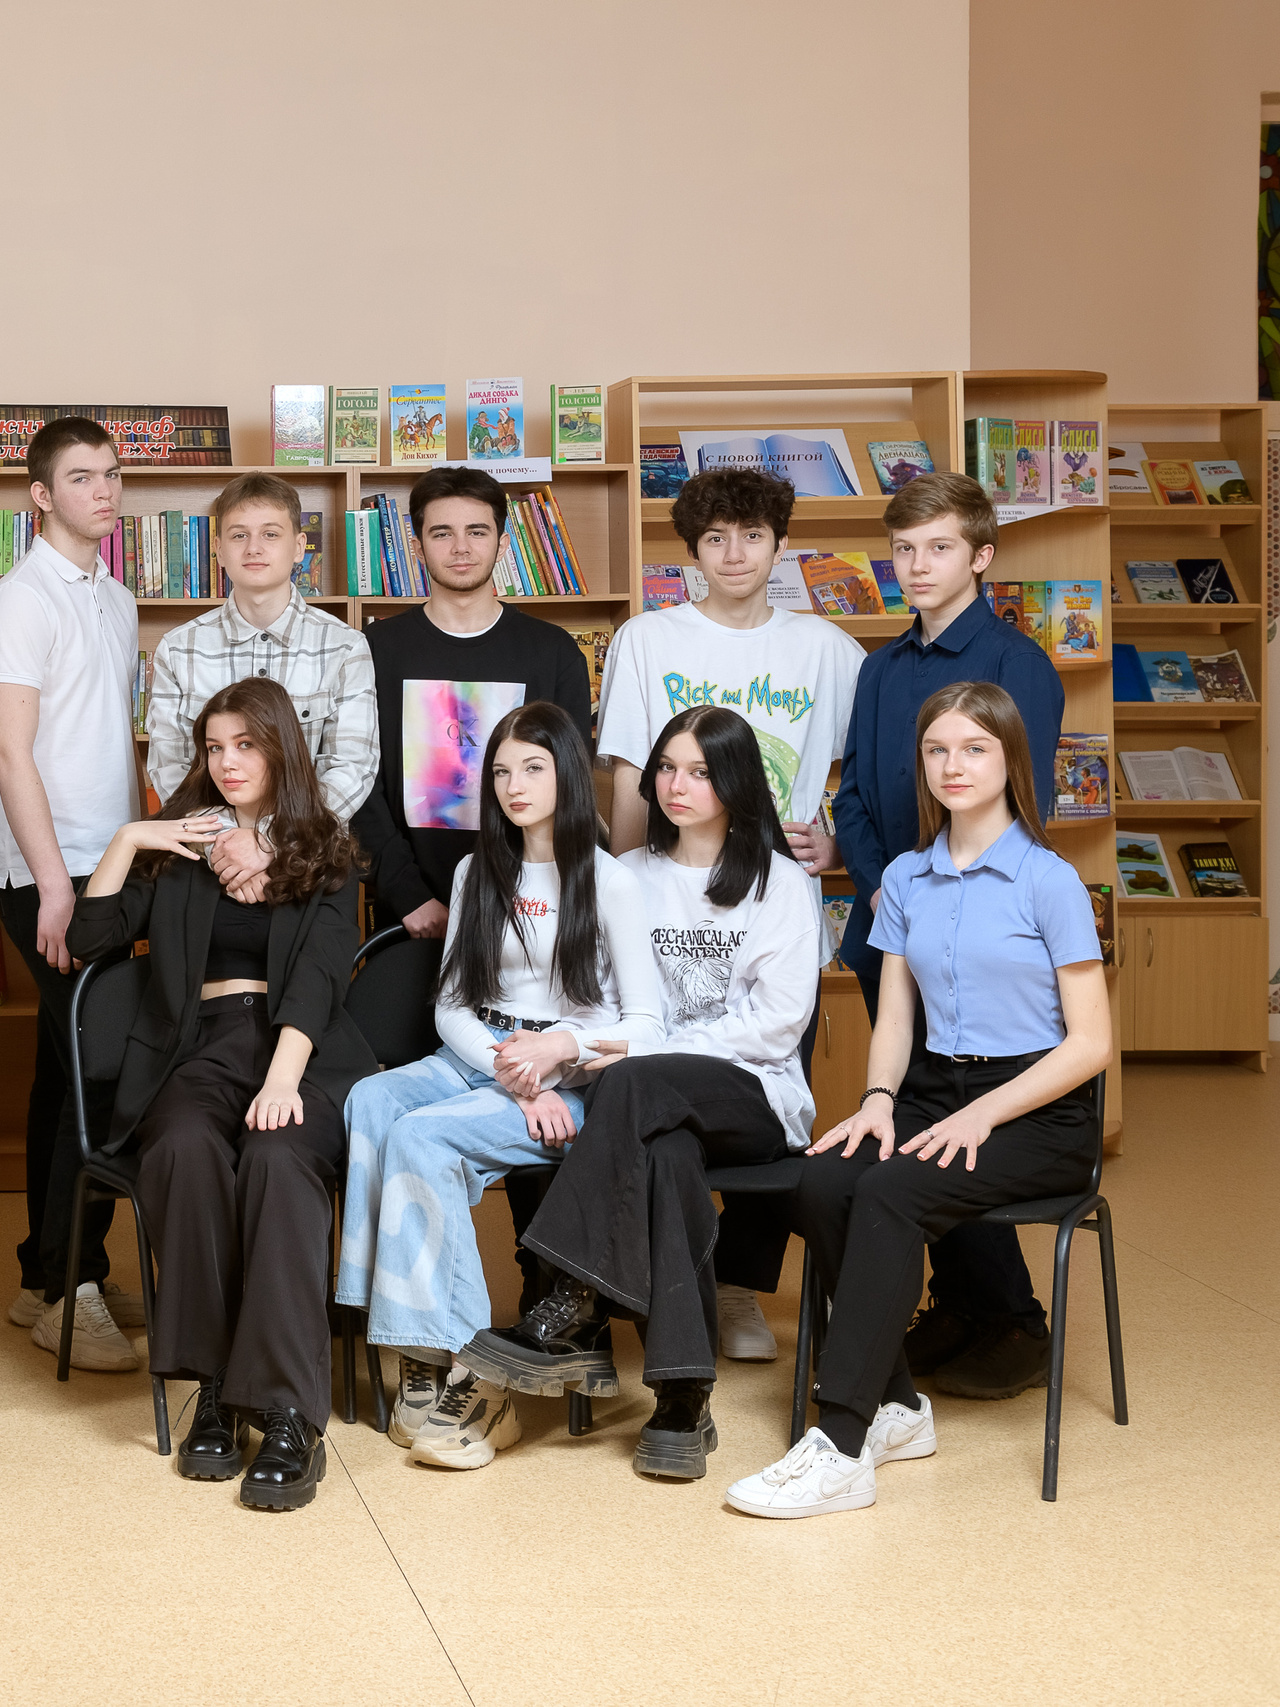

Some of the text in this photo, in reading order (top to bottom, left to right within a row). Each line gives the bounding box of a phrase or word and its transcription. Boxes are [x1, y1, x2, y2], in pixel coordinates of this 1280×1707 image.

[468, 391, 492, 399] ДИКАЯ
[560, 396, 600, 405] ТОЛСТОЙ
[337, 399, 377, 408] ГОГОЛЬ
[396, 395, 442, 408] Сервантес
[480, 397, 508, 405] ДИНГО
[1061, 430, 1098, 452] АЛИСА
[117, 443, 176, 459] EXT
[401, 452, 438, 461] Дон Кихот
[705, 452, 823, 463] С НОВОЙ КНИГОЙ
[383, 527, 397, 572] КОМПЬЮТЕР
[359, 538, 367, 581] Естественные
[647, 584, 677, 594] Online
[1194, 857, 1236, 868] ТАНКИ XXI
[650, 928, 748, 947] MECHANICAL AG
[659, 945, 733, 959] CONTENT
